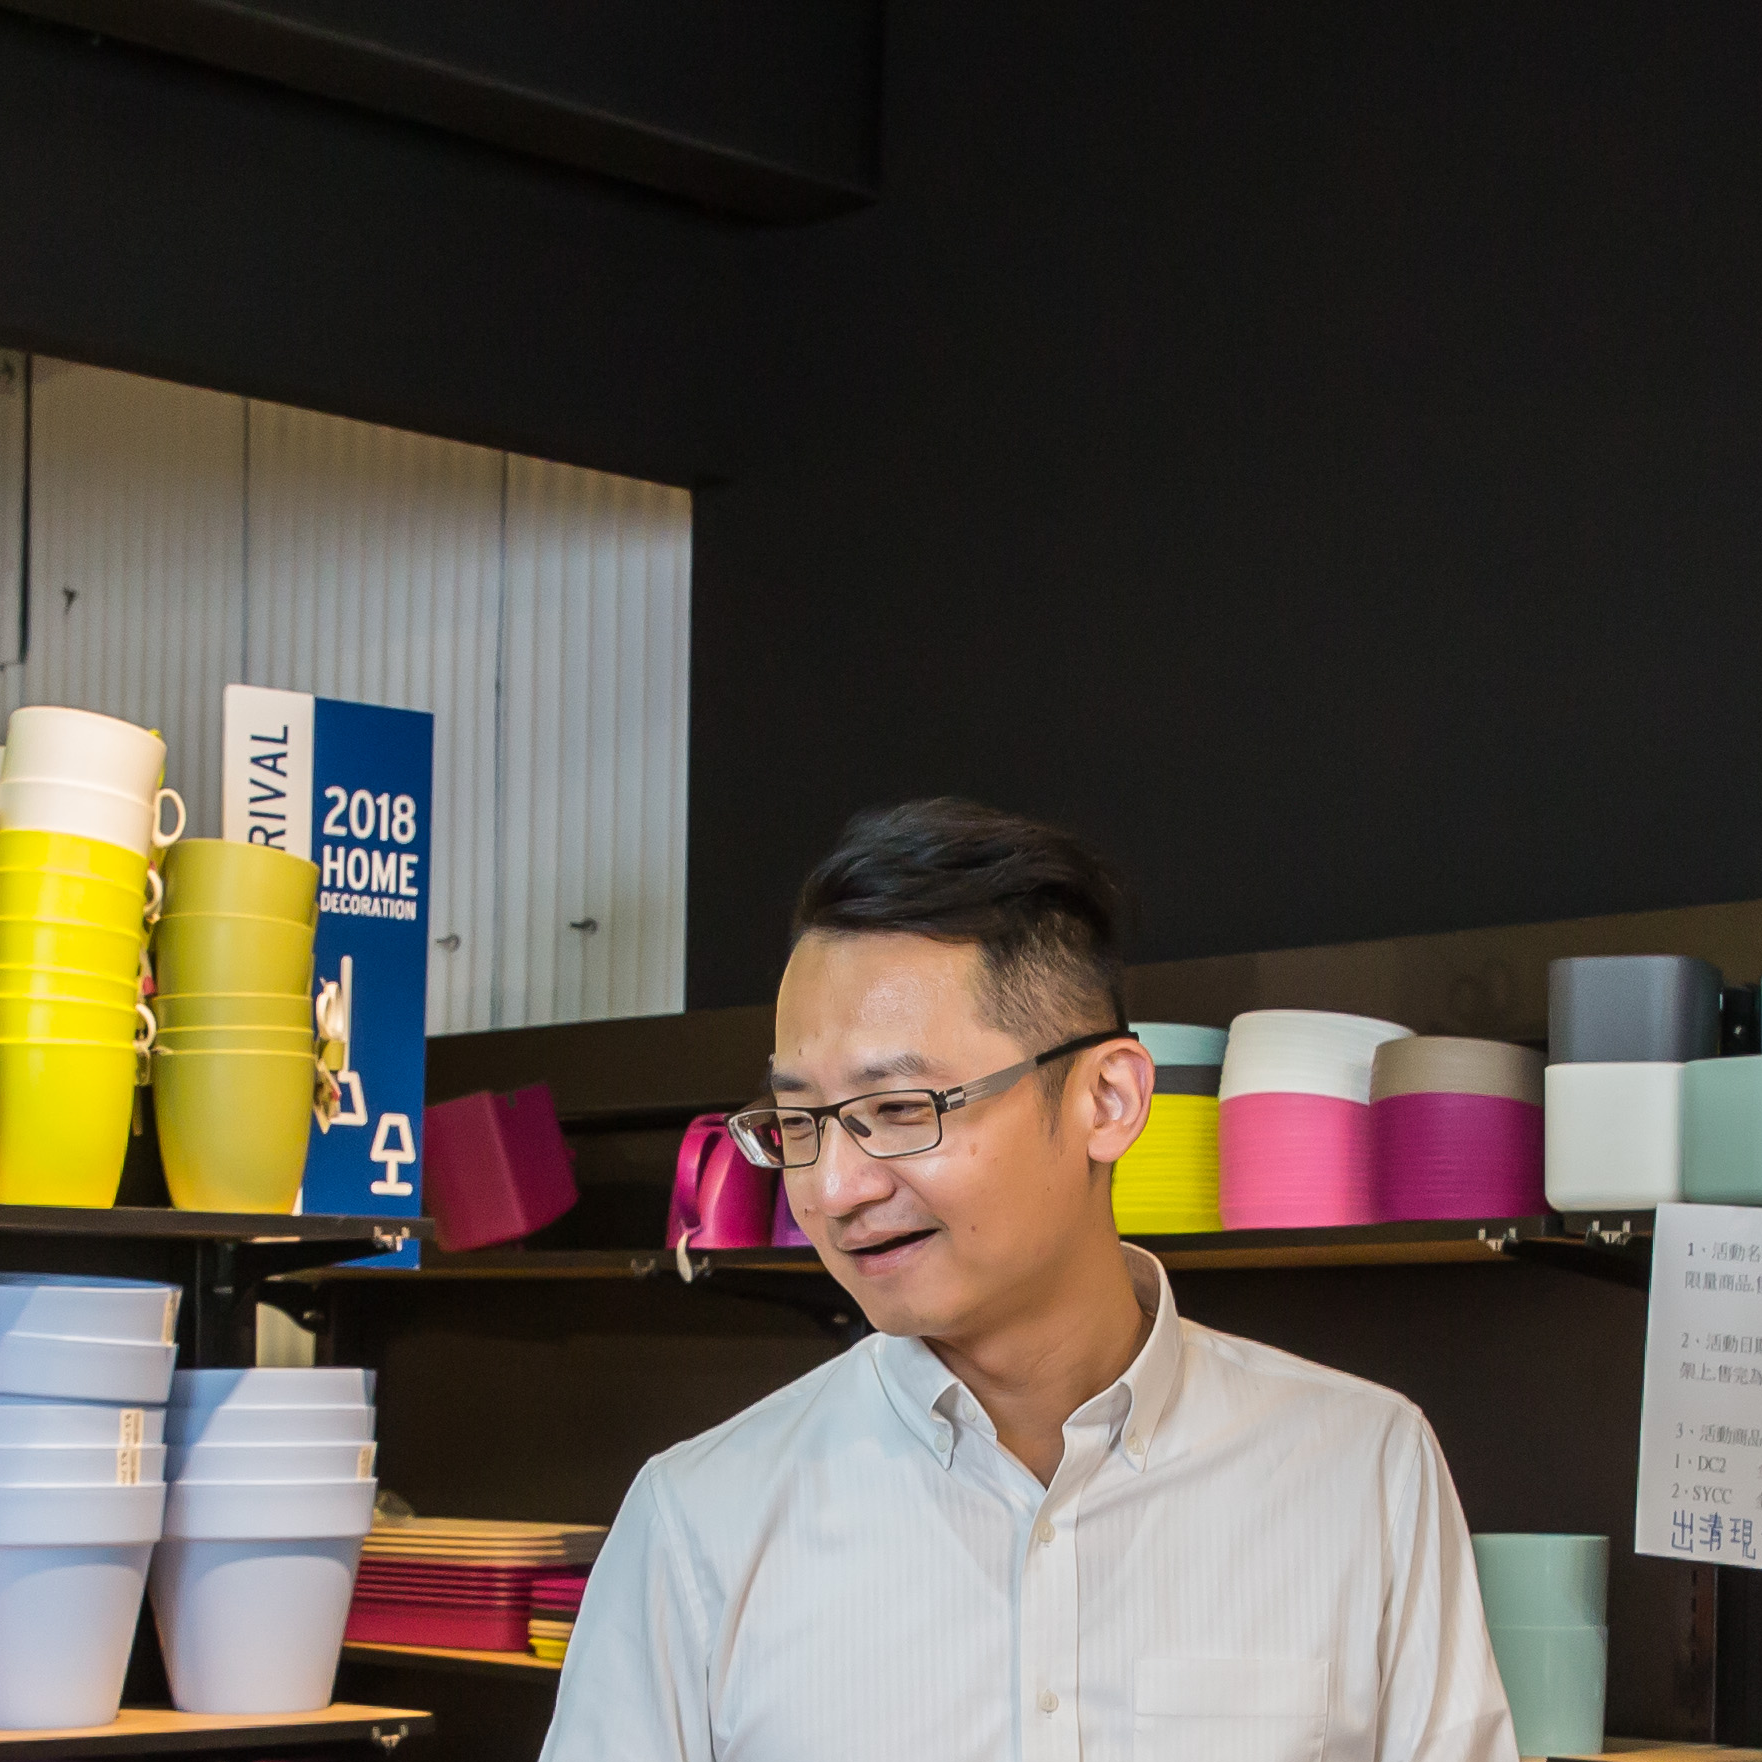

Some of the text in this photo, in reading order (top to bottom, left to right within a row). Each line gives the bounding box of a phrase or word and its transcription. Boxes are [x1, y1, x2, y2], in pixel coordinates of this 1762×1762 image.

[323, 785, 417, 845] 2018
[322, 844, 419, 897] HOME
[319, 890, 417, 921] DECORATION
